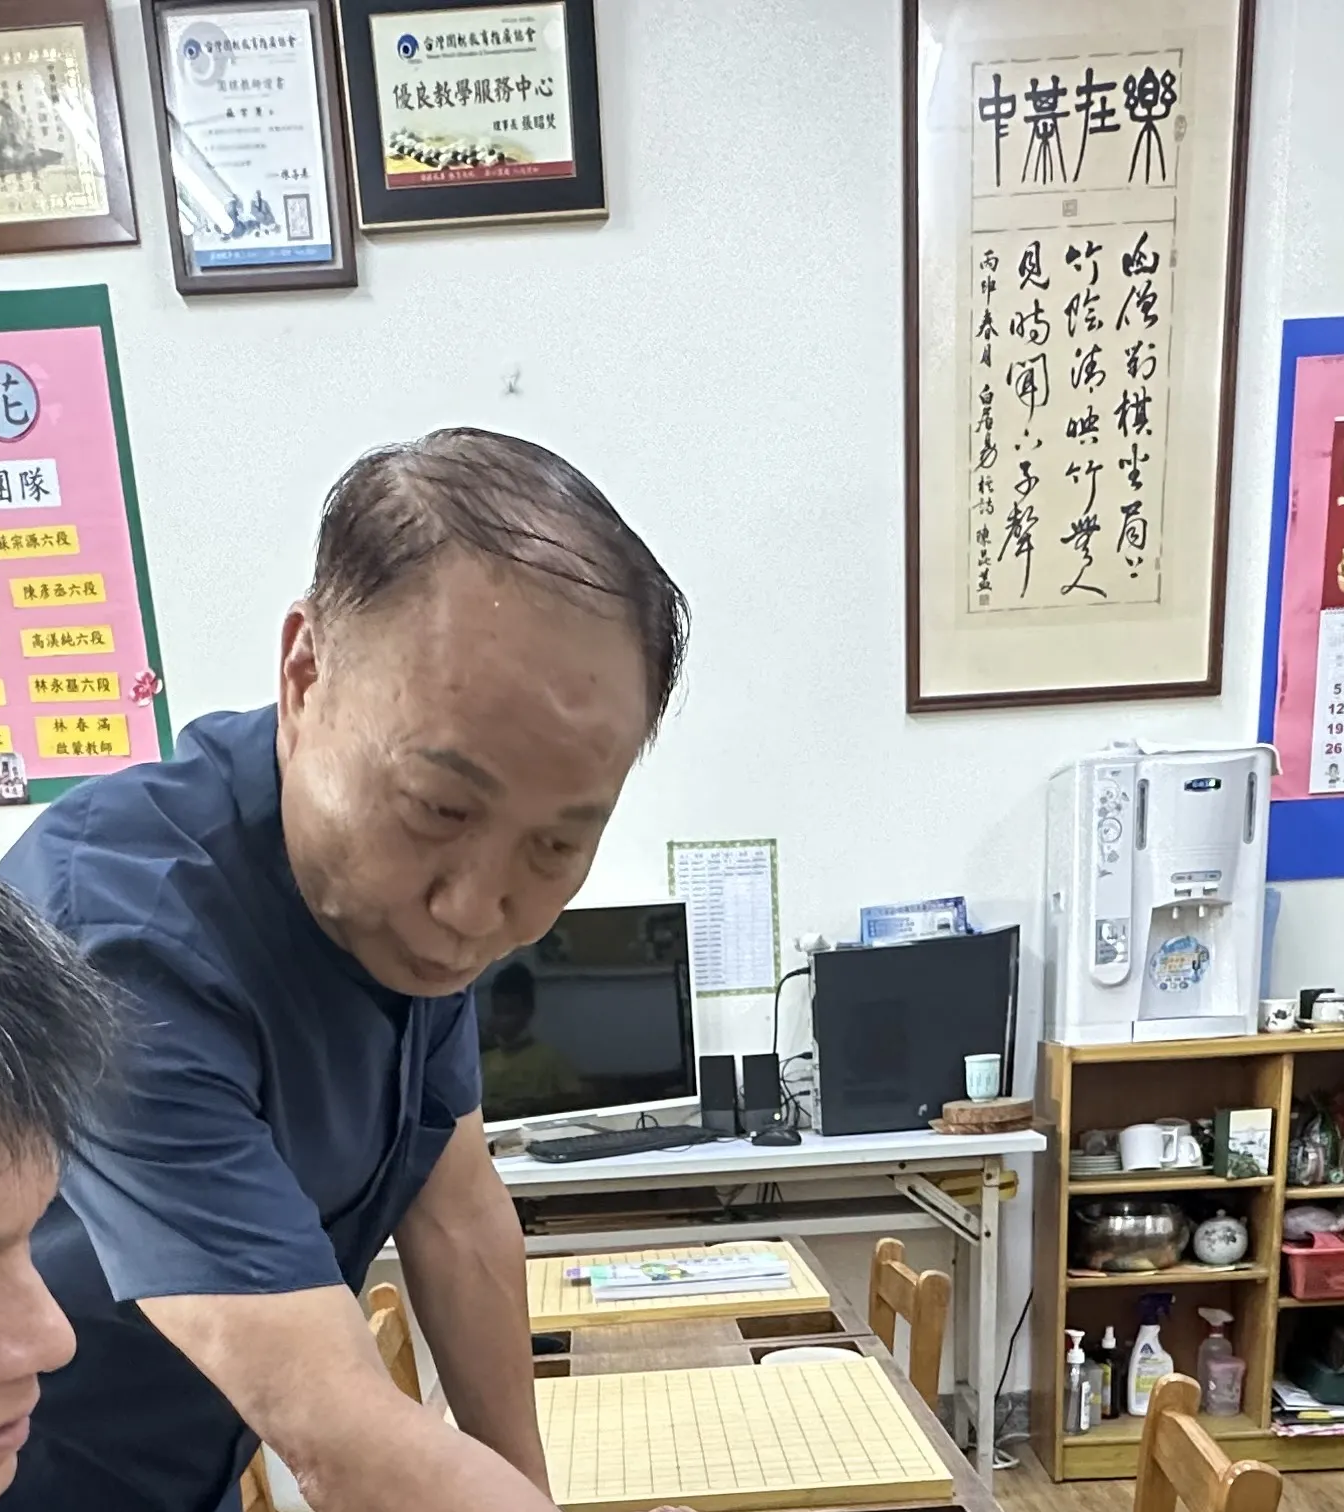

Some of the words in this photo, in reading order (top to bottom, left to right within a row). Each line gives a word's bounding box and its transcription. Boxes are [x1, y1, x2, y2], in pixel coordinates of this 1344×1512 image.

[393, 74, 554, 111] 優良教學服務中心
[1333, 683, 1342, 695] 5
[1328, 703, 1344, 715] 12
[1327, 722, 1344, 735] 19
[1325, 742, 1342, 755] 26
